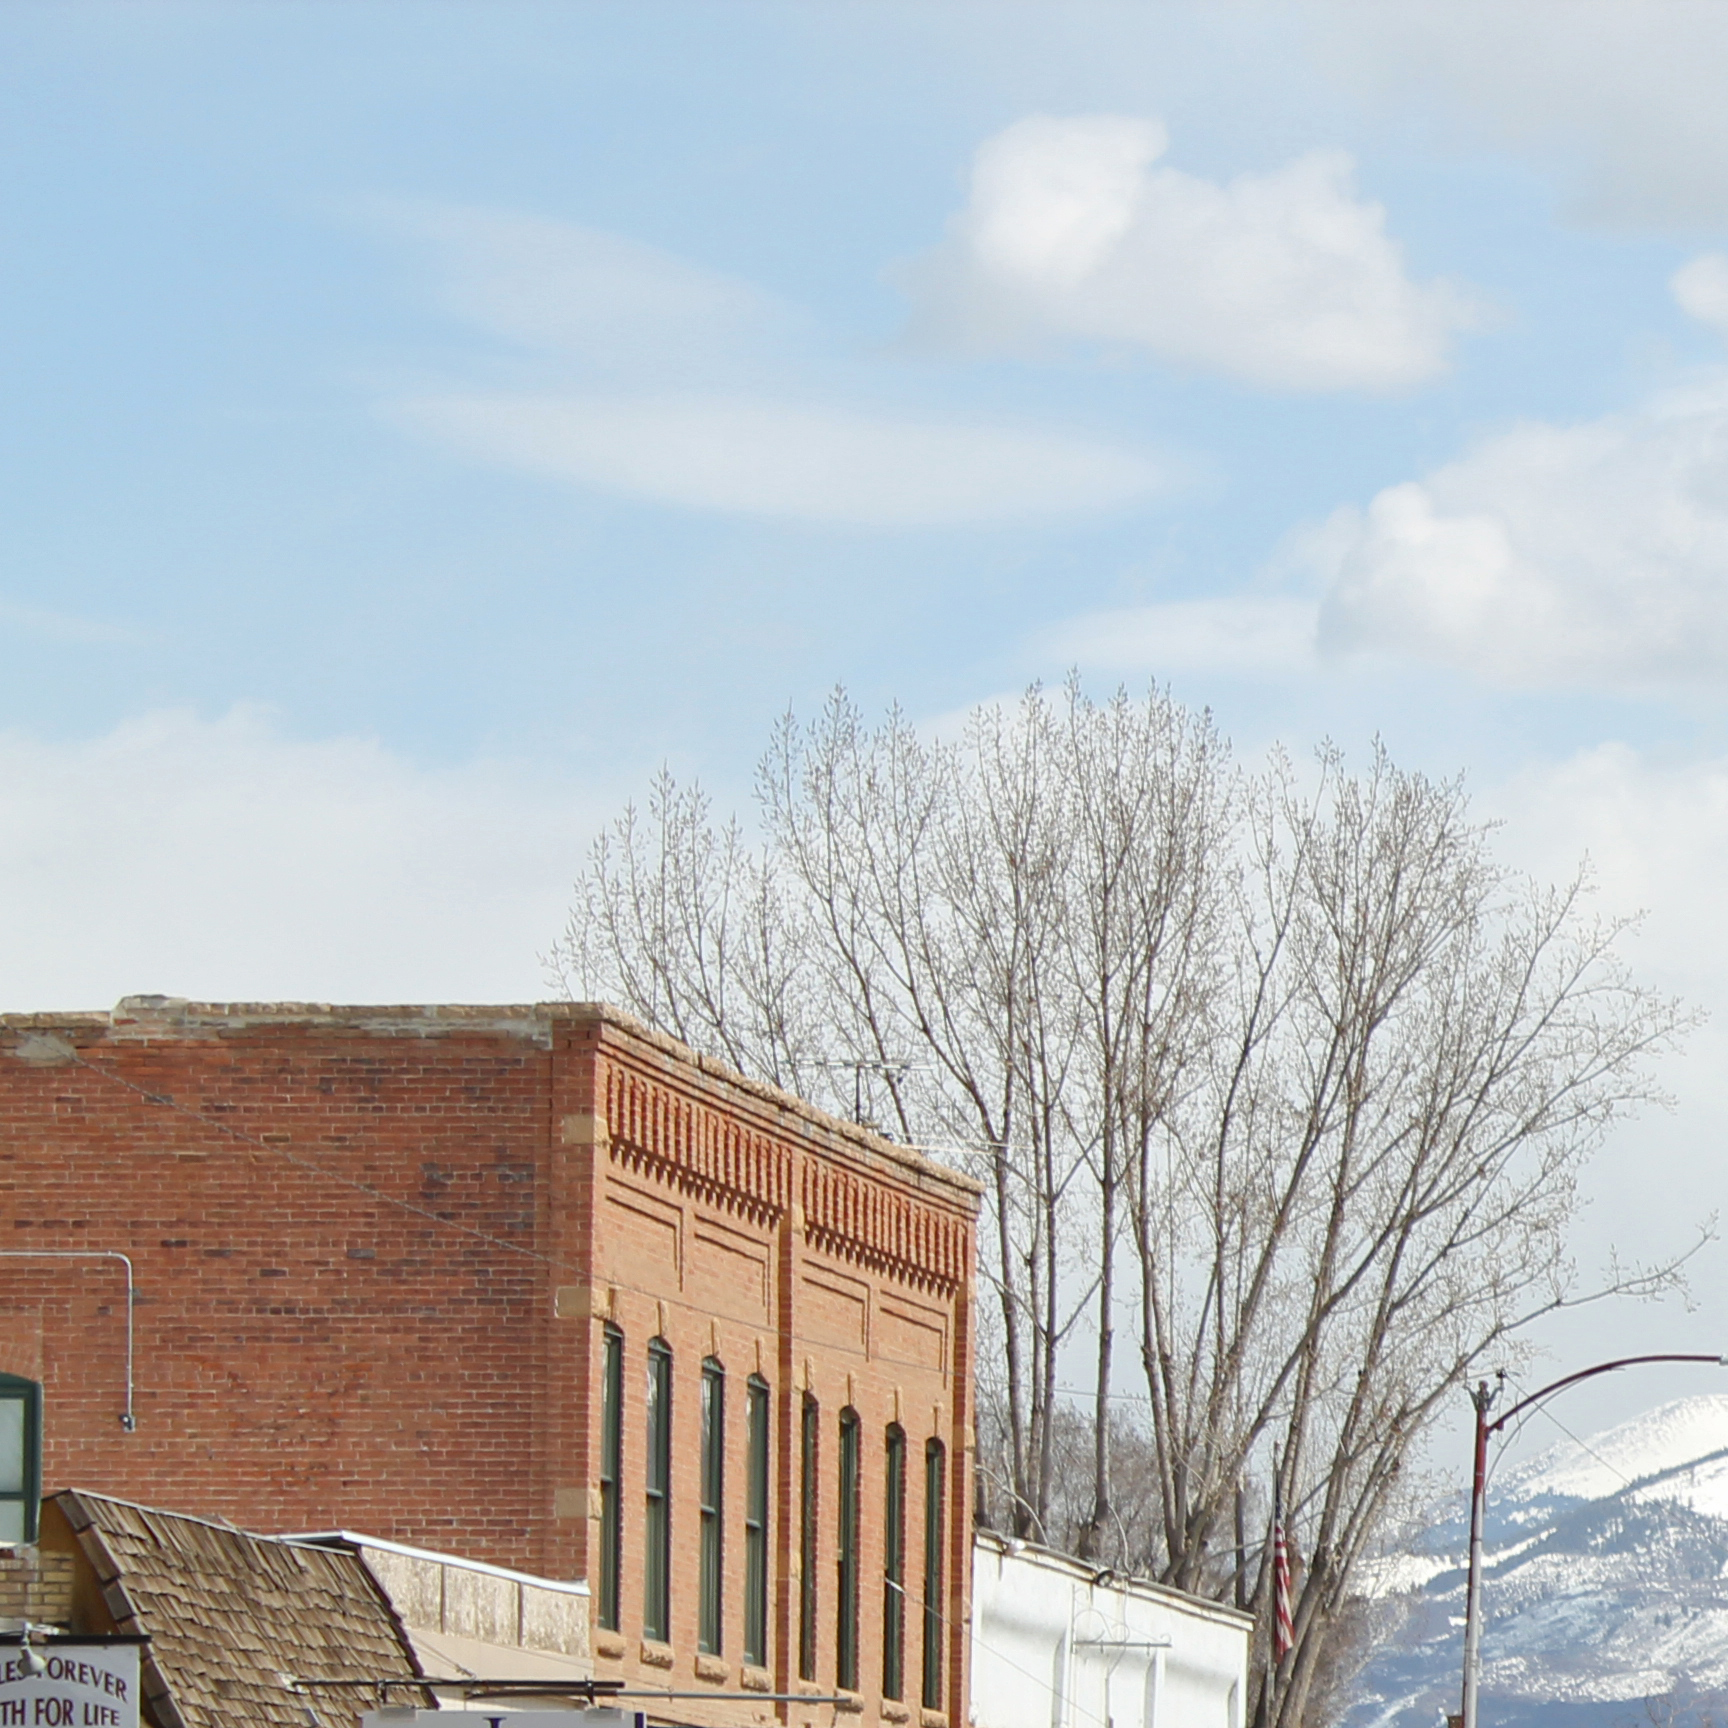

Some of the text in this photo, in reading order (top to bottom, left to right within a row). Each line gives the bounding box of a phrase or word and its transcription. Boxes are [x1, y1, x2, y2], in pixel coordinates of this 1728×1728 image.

[38, 1656, 127, 1704] OREVER
[35, 1697, 74, 1727] FOR
[84, 1702, 120, 1726] LIFE
